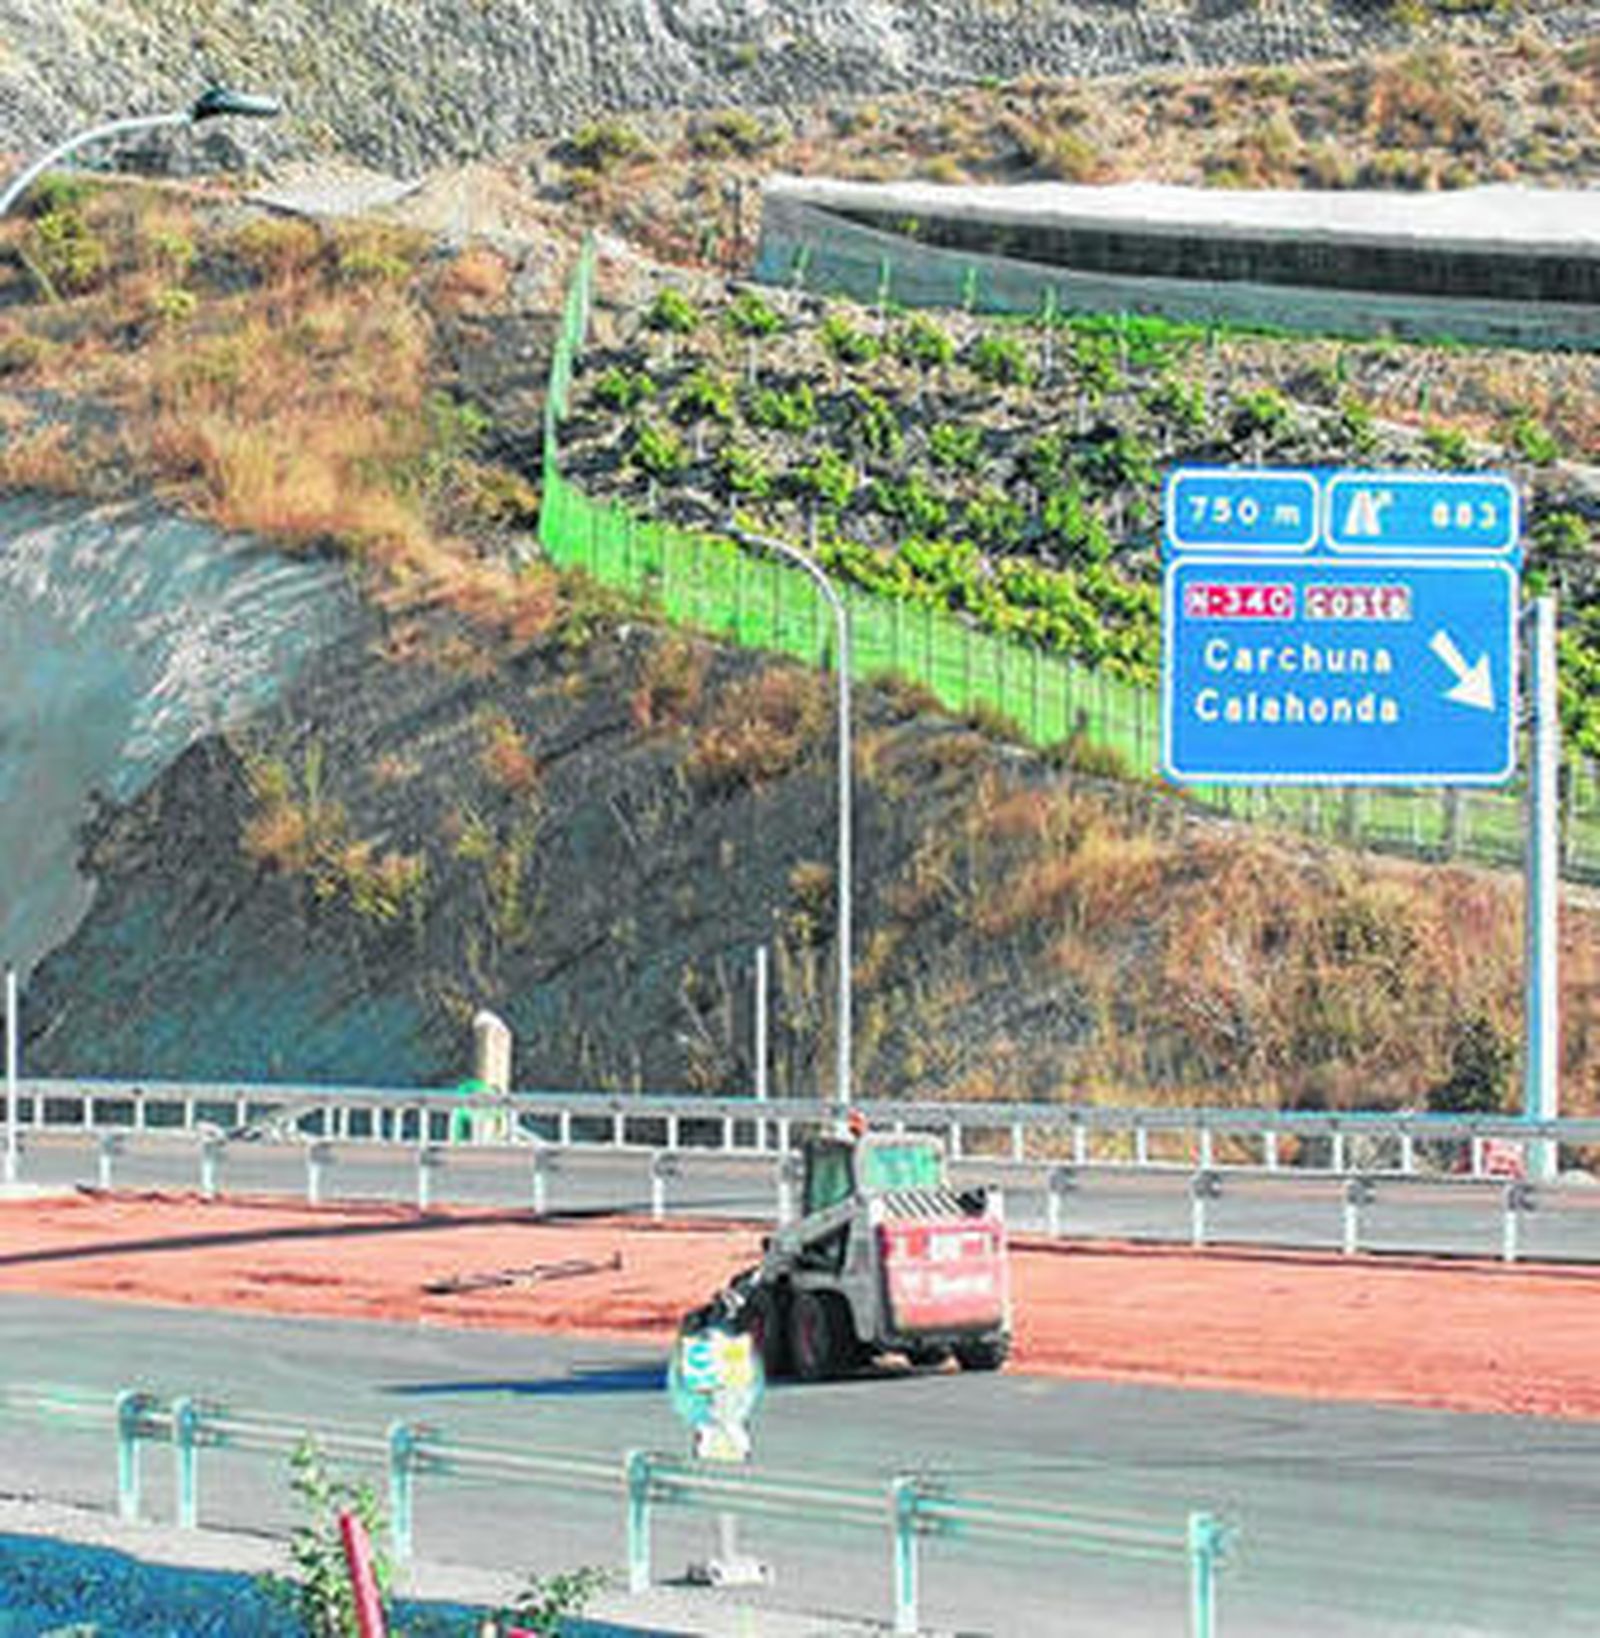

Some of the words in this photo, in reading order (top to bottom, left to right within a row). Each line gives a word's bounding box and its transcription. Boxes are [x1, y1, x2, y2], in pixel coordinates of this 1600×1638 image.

[1189, 496, 1259, 525] 750
[1275, 504, 1300, 526] m
[1190, 589, 1291, 615] N-340
[1204, 638, 1392, 672] Carchuna
[1194, 688, 1398, 722] Calahonda
